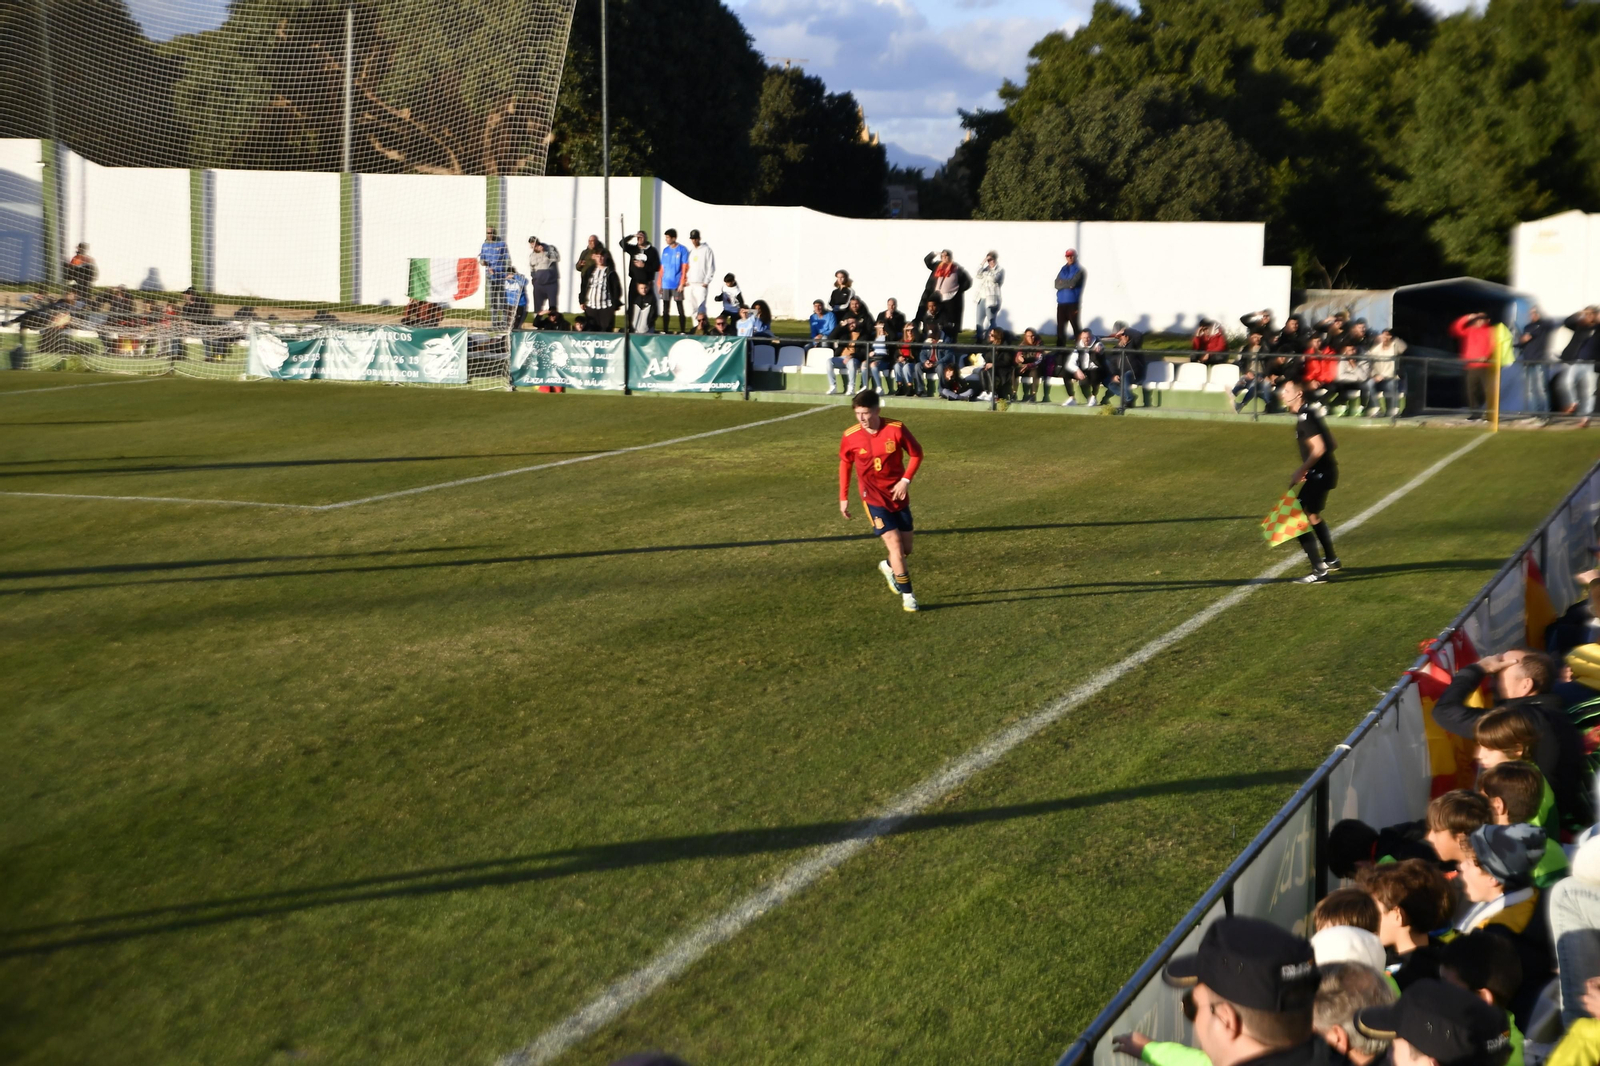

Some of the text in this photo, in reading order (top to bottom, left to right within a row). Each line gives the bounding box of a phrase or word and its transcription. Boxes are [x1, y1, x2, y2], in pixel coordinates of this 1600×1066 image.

[292, 354, 309, 362] 695
[393, 355, 405, 364] 26
[571, 365, 582, 373] 951
[595, 366, 604, 374] 31
[545, 377, 573, 385] ARRIOL
[874, 457, 882, 471] 8
